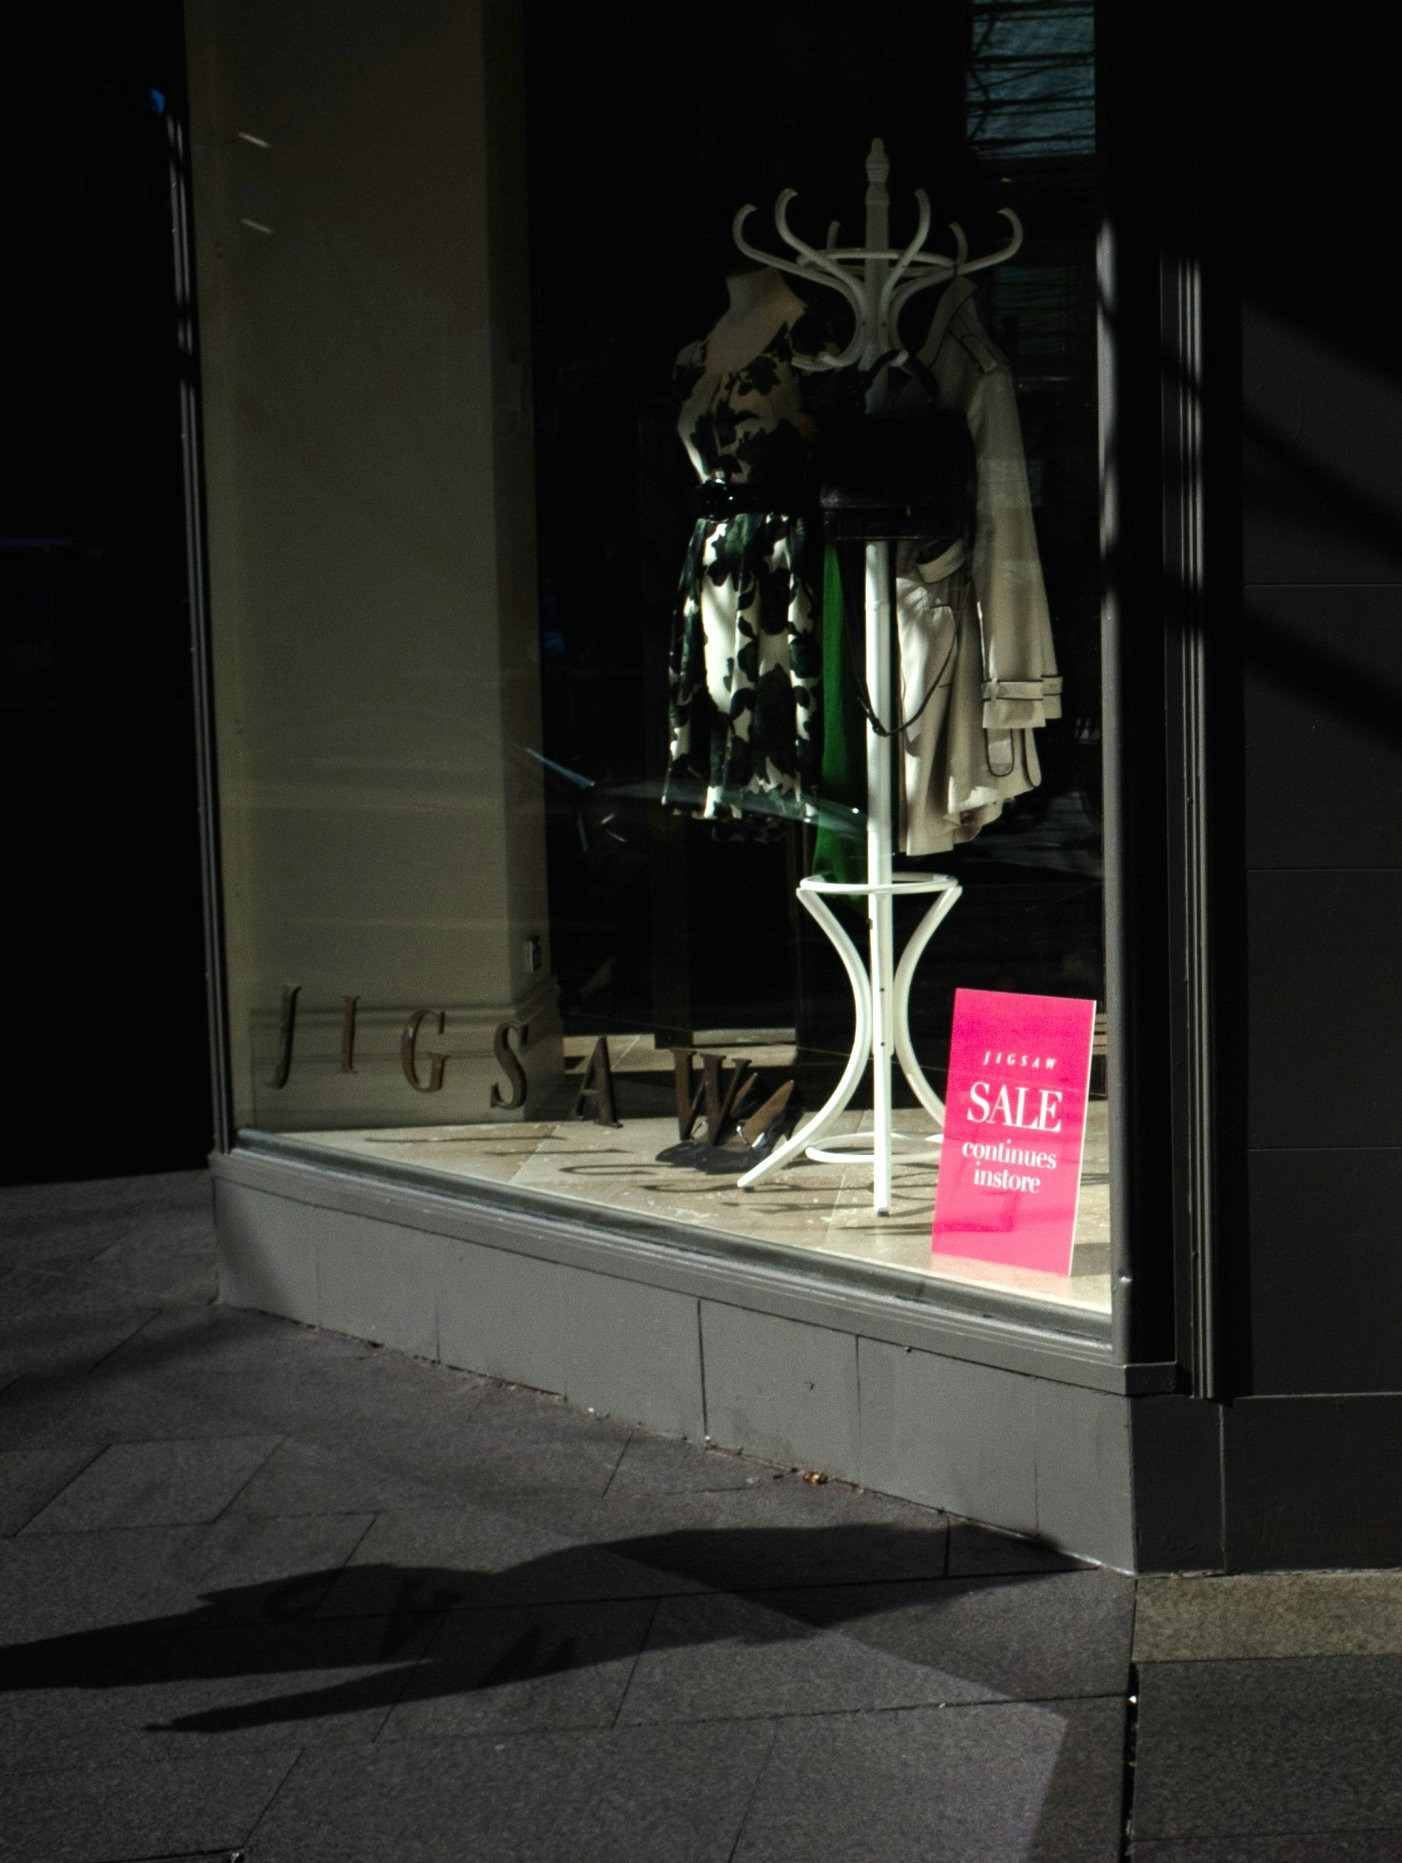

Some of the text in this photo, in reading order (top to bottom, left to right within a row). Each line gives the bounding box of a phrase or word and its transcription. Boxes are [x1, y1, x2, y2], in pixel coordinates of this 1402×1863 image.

[264, 984, 752, 1147] JIGSAW
[982, 1050, 1058, 1069] JIGSAW
[966, 1081, 1063, 1133] SALE
[962, 1139, 1057, 1170] continues
[973, 1161, 1041, 1194] instore
